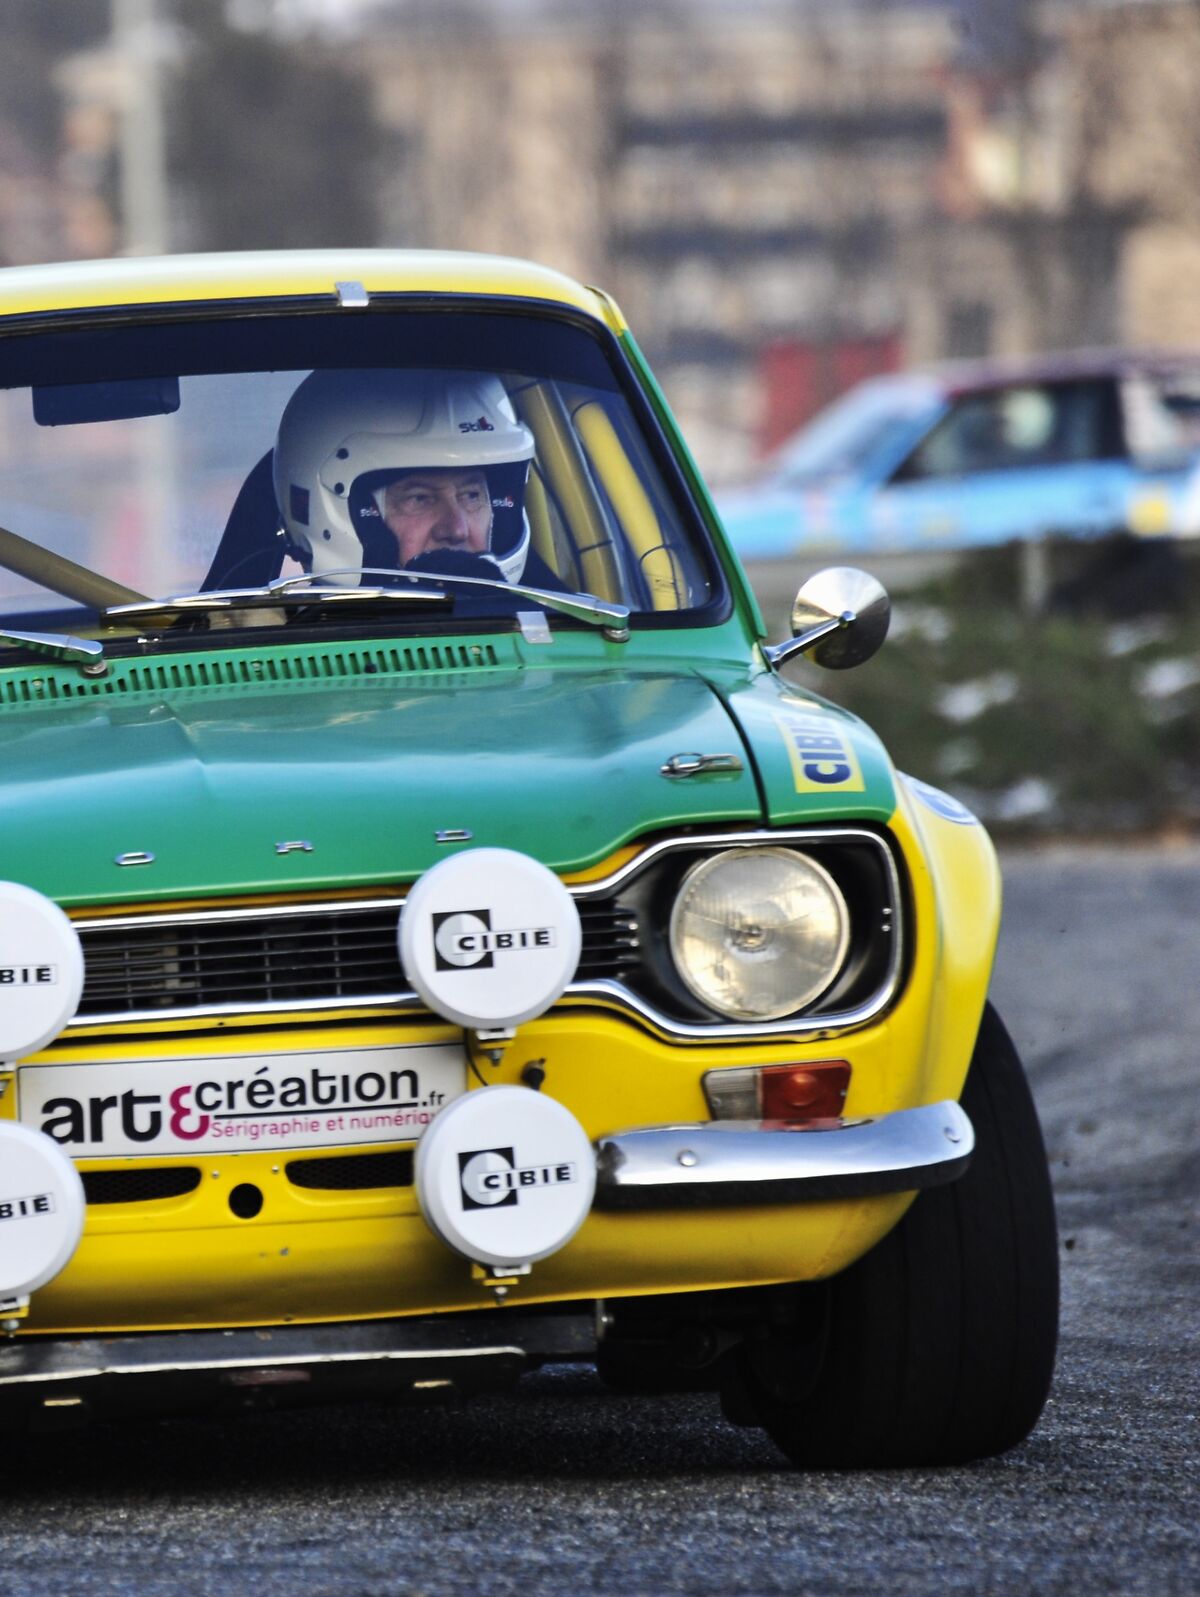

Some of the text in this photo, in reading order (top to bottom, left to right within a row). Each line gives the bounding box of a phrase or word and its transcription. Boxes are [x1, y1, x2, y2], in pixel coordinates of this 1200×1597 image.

[211, 1108, 437, 1141] Sérigraphie et numériq
